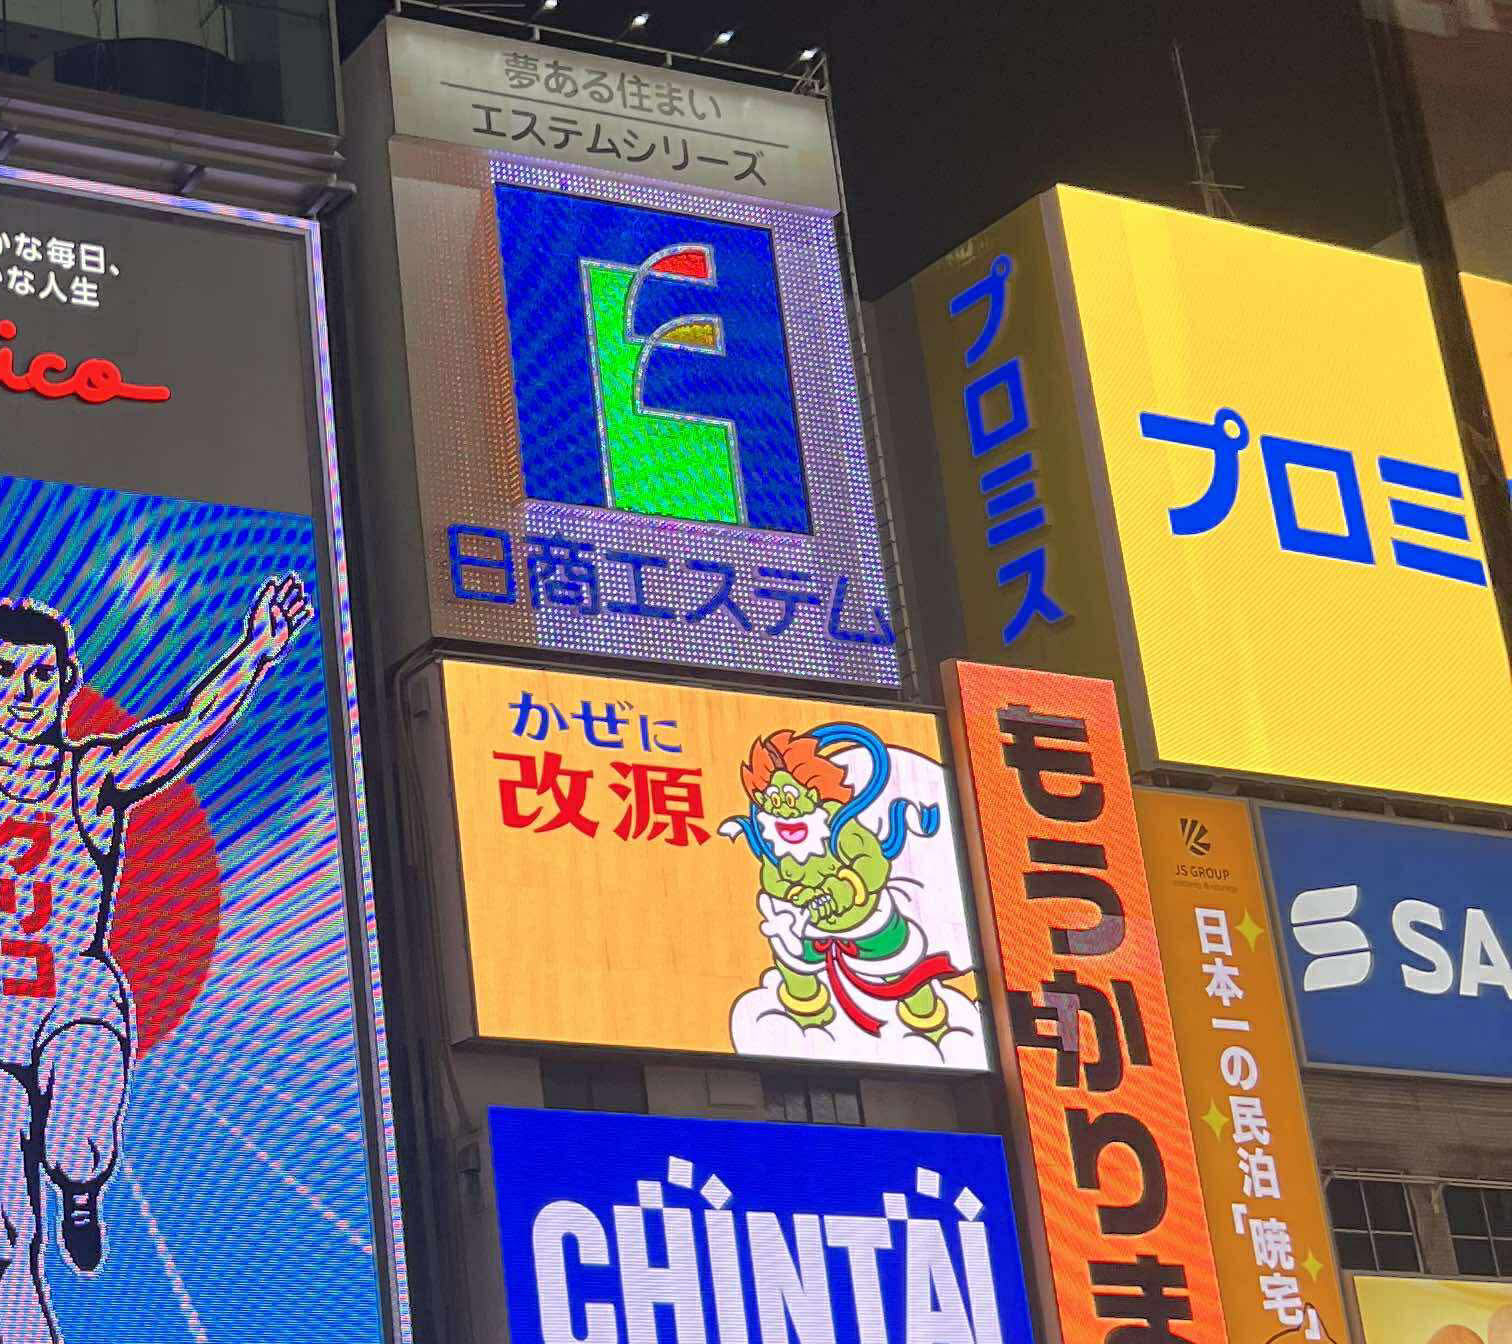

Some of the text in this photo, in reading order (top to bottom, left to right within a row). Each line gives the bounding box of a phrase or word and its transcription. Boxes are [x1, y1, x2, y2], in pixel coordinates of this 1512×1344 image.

[504, 53, 722, 122] 夢ある住まい
[471, 104, 768, 187] エステムシリーズ
[948, 252, 1066, 646] プロミス
[1138, 406, 1489, 588] プロミ
[447, 523, 896, 644] 日商エステム
[508, 691, 684, 753] かぜに
[492, 750, 714, 847] 改源
[1190, 866, 1230, 880] GROUP
